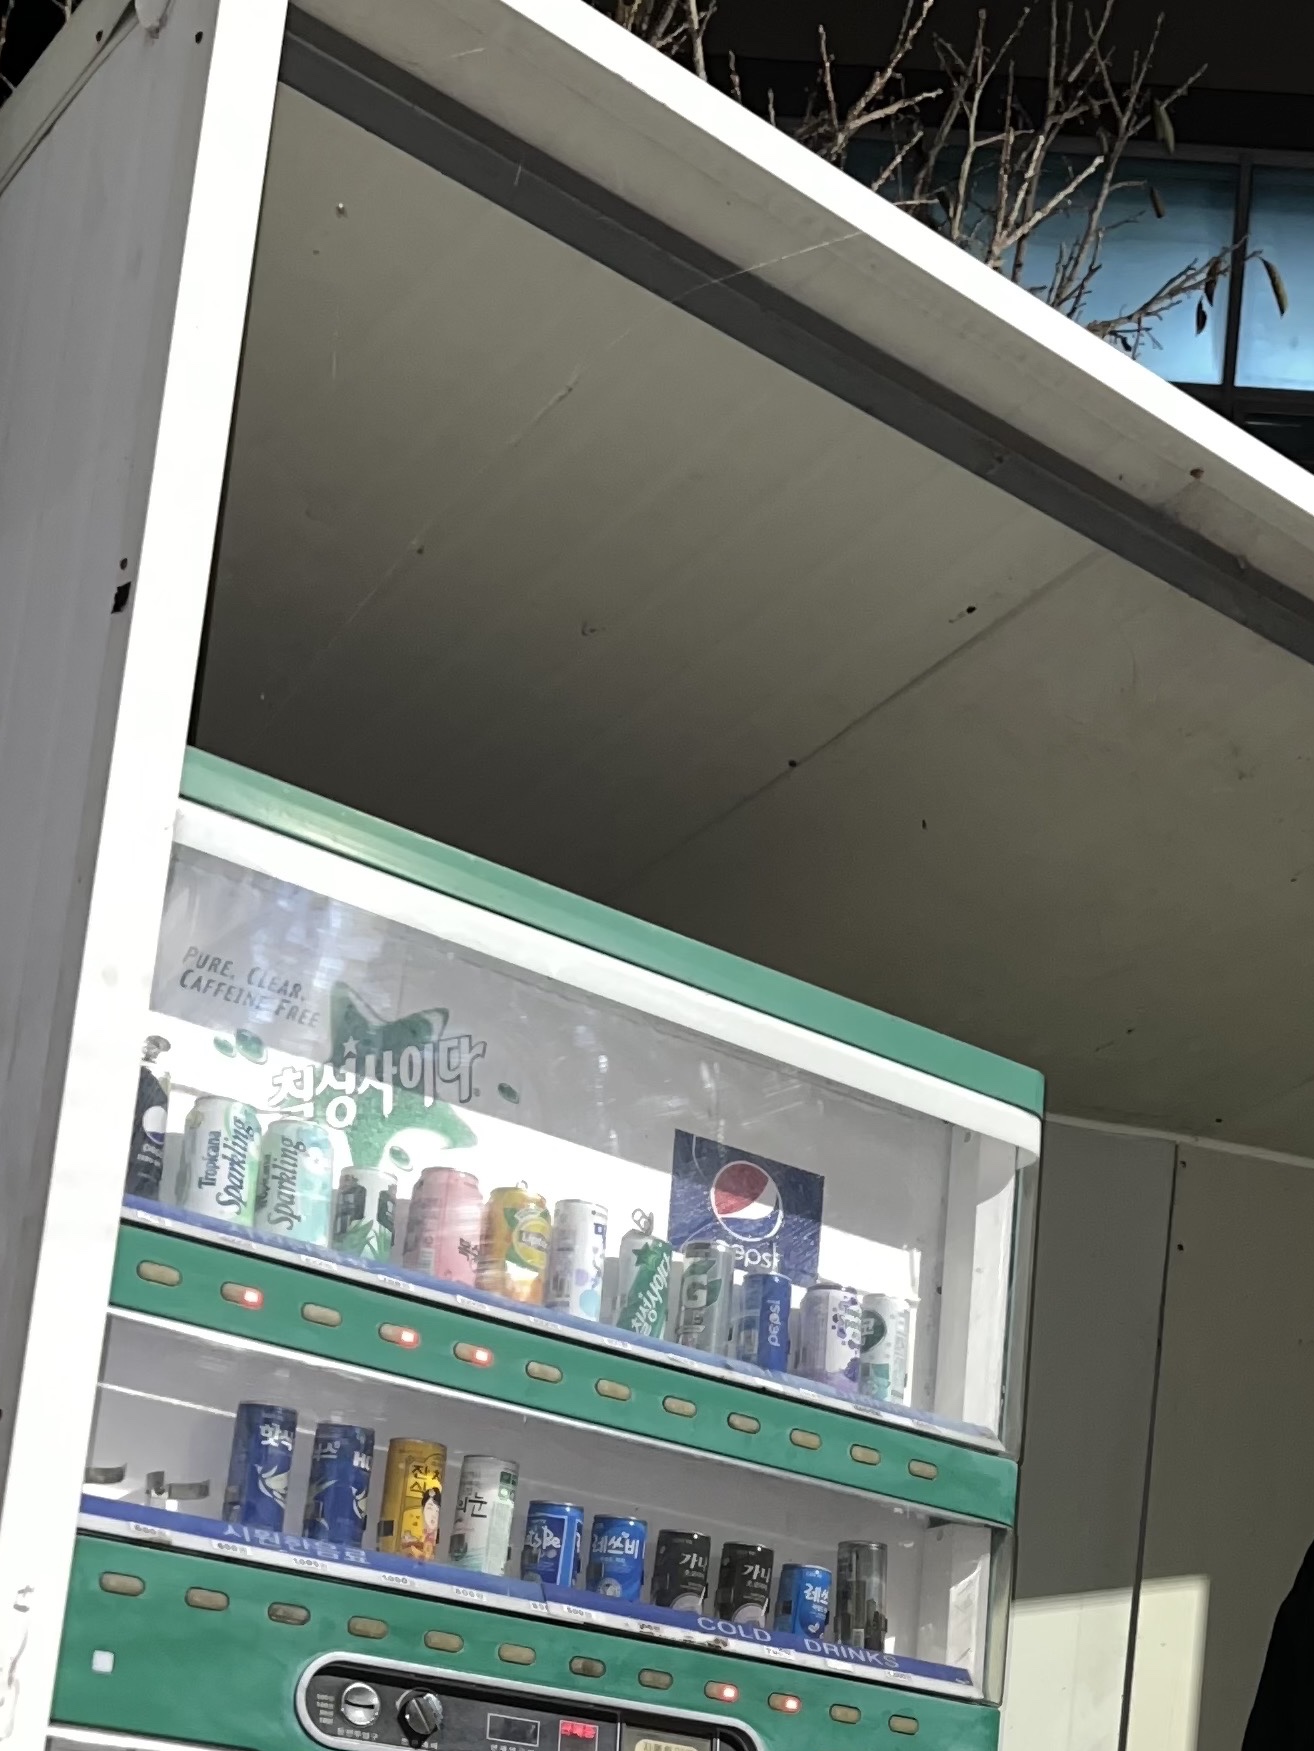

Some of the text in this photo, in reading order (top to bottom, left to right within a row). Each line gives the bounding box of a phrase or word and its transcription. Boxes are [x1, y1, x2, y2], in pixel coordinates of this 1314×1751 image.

[183, 945, 235, 980] PURE.
[274, 998, 321, 1028] FREE
[264, 1034, 488, 1130] 칠성사이다
[216, 1109, 255, 1216] Sparkling
[267, 1134, 307, 1231] Sparkling
[767, 1299, 781, 1347] pepsi
[697, 1616, 772, 1643] COLD
[804, 1638, 900, 1669] DRINKS
